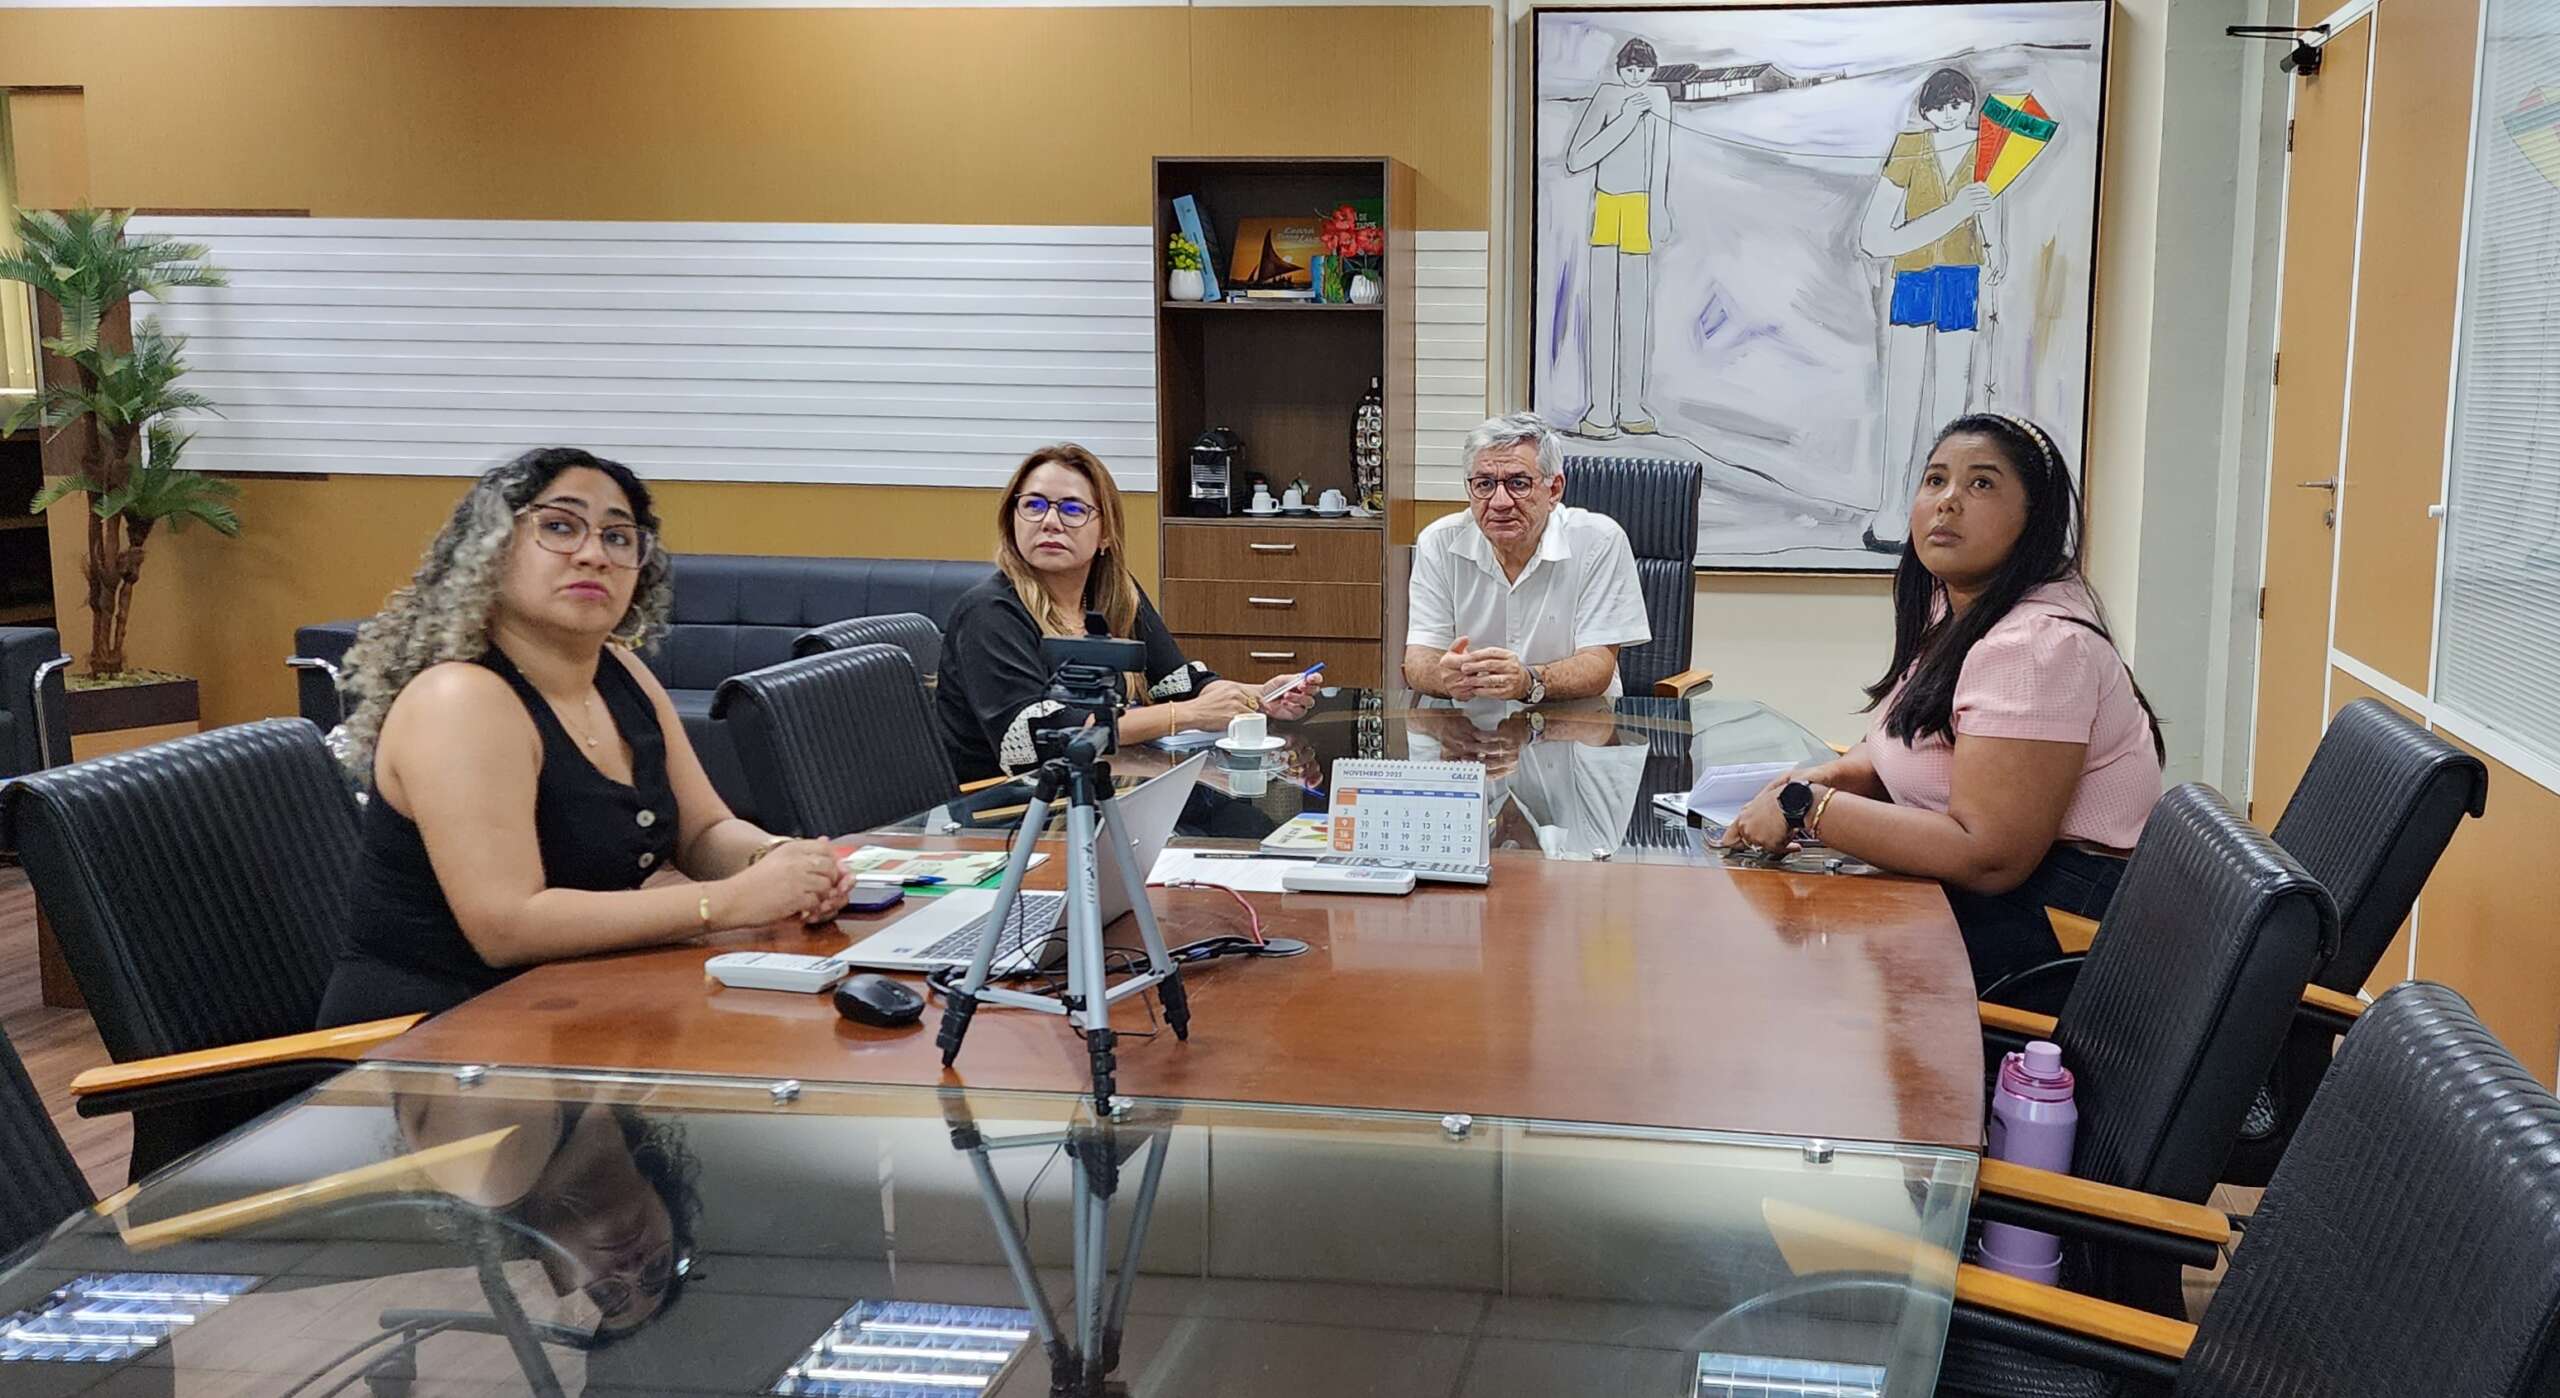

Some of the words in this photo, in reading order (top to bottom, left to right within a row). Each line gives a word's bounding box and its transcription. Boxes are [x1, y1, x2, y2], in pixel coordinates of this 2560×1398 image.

[1343, 769, 1384, 777] NOVEMBRO
[1451, 772, 1479, 781] CAIXA
[1421, 833, 1431, 841] 20
[1461, 835, 1472, 843] 22
